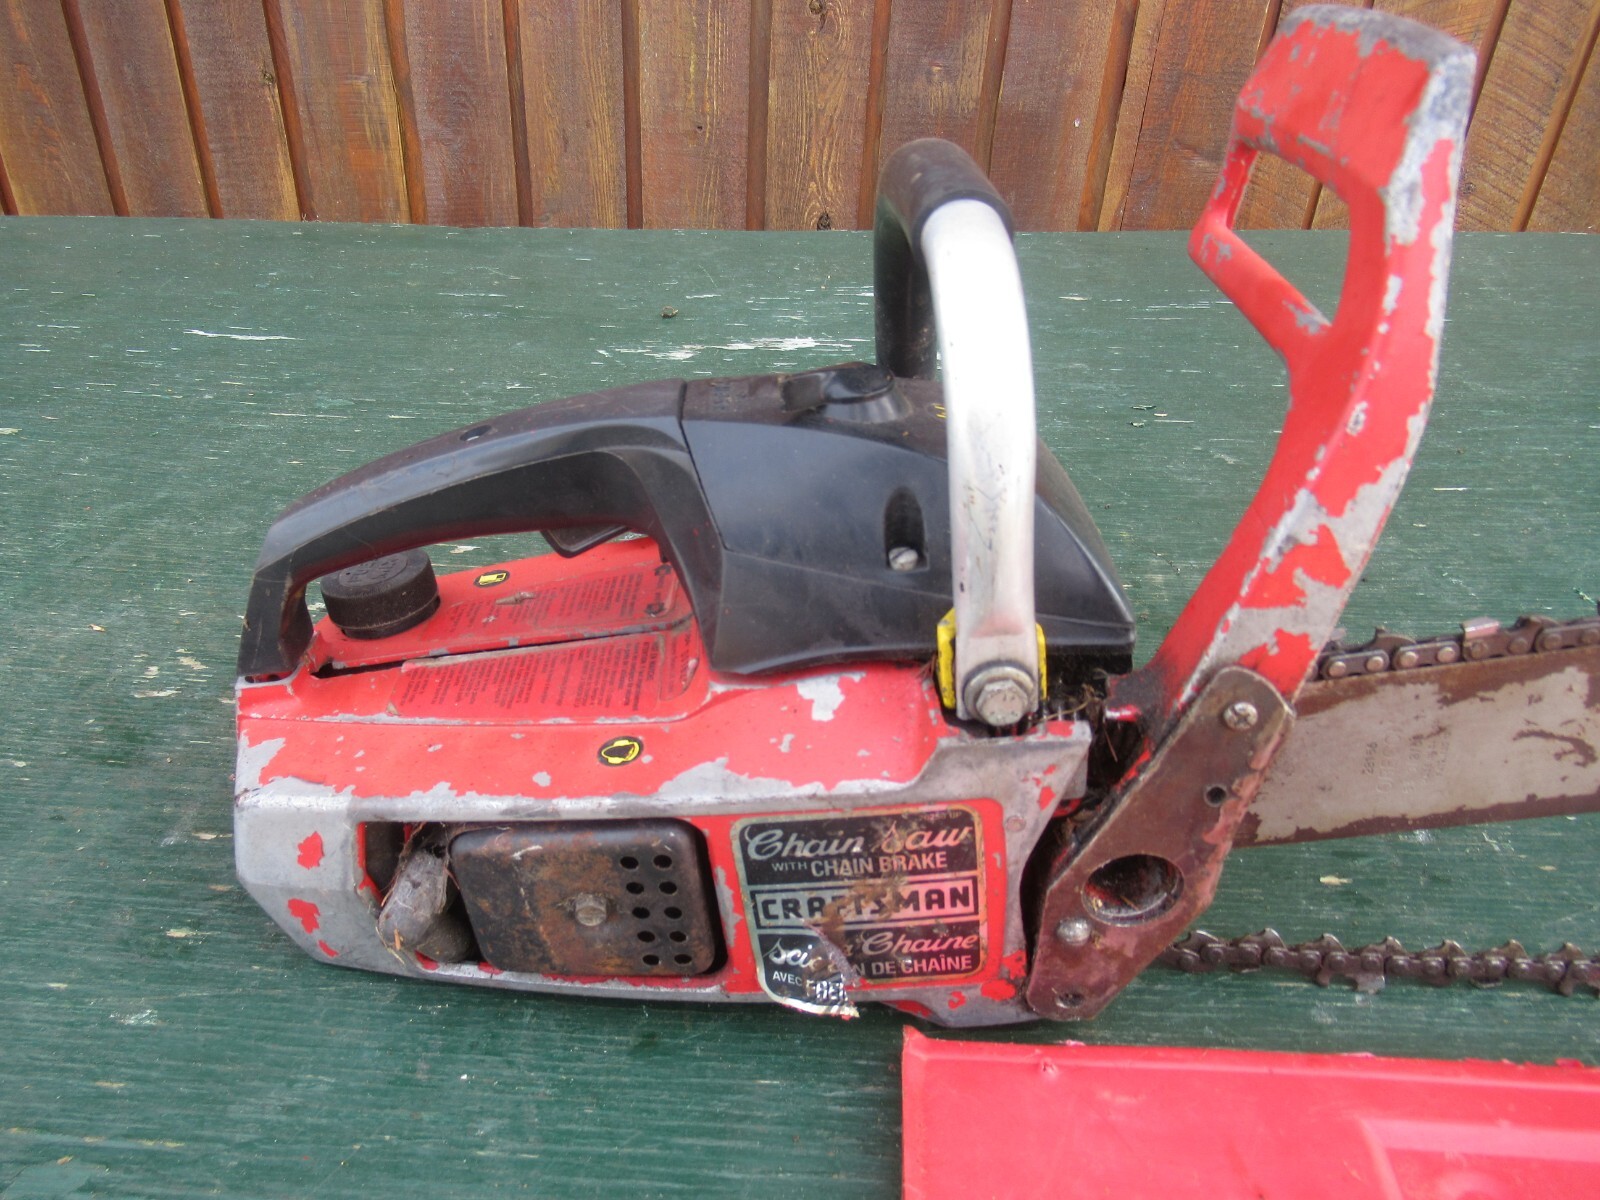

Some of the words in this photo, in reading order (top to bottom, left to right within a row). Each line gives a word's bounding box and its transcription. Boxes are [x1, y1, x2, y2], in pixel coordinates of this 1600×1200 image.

[744, 825, 864, 860] Chain
[872, 820, 973, 854] Saw
[771, 861, 808, 872] WITH
[810, 857, 874, 877] CHAIN
[878, 851, 948, 873] BRAKE
[772, 971, 803, 986] AVEC
[872, 961, 896, 975] DE
[901, 954, 972, 974] CHAÎNE
